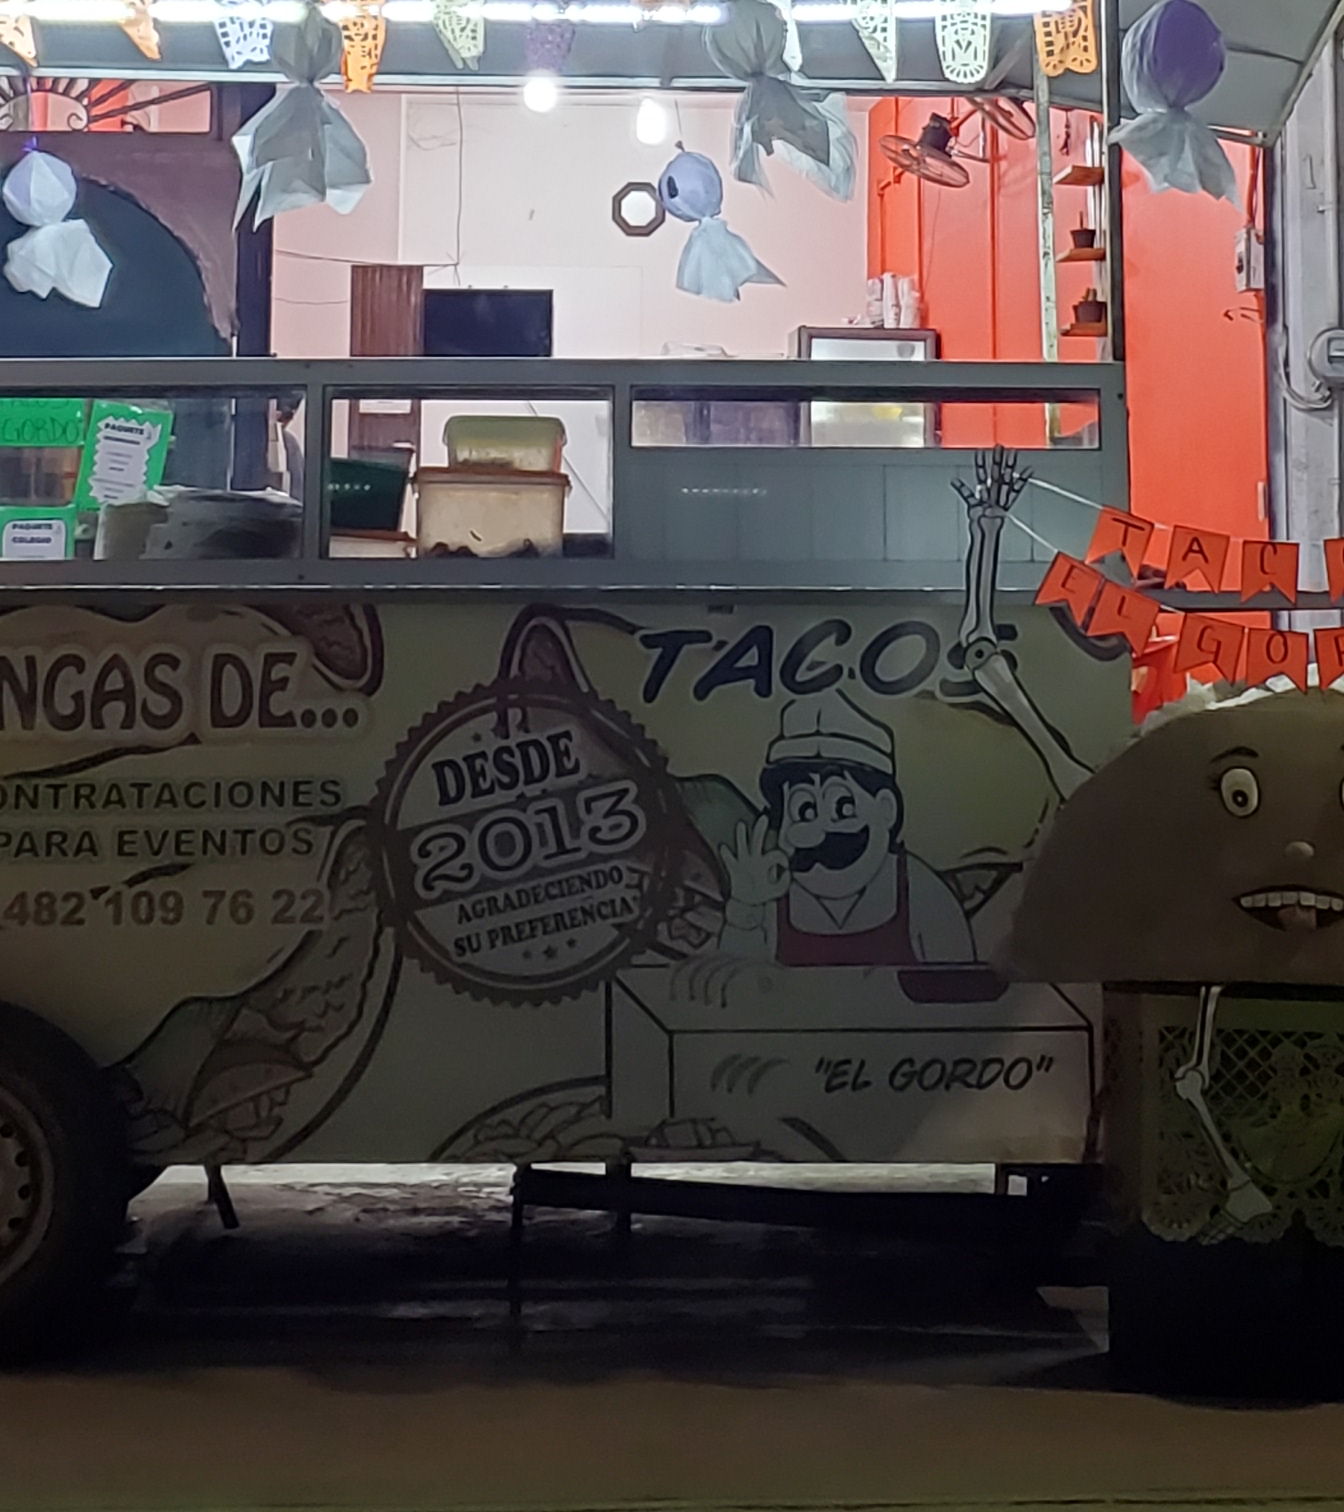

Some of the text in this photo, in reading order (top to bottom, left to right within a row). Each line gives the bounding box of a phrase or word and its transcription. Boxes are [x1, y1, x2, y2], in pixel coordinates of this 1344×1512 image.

[1058, 564, 1133, 621] EL
[207, 651, 360, 729] DE...
[432, 730, 582, 807] DESDE
[116, 827, 315, 858] EVENTOS
[416, 786, 642, 892] 2013
[2, 889, 326, 927] 482 109 76 22
[456, 864, 624, 925] AGRADECIENDO
[453, 897, 634, 958] SU PREFERENCIA
[814, 1055, 1055, 1093] "EL GORDO"
